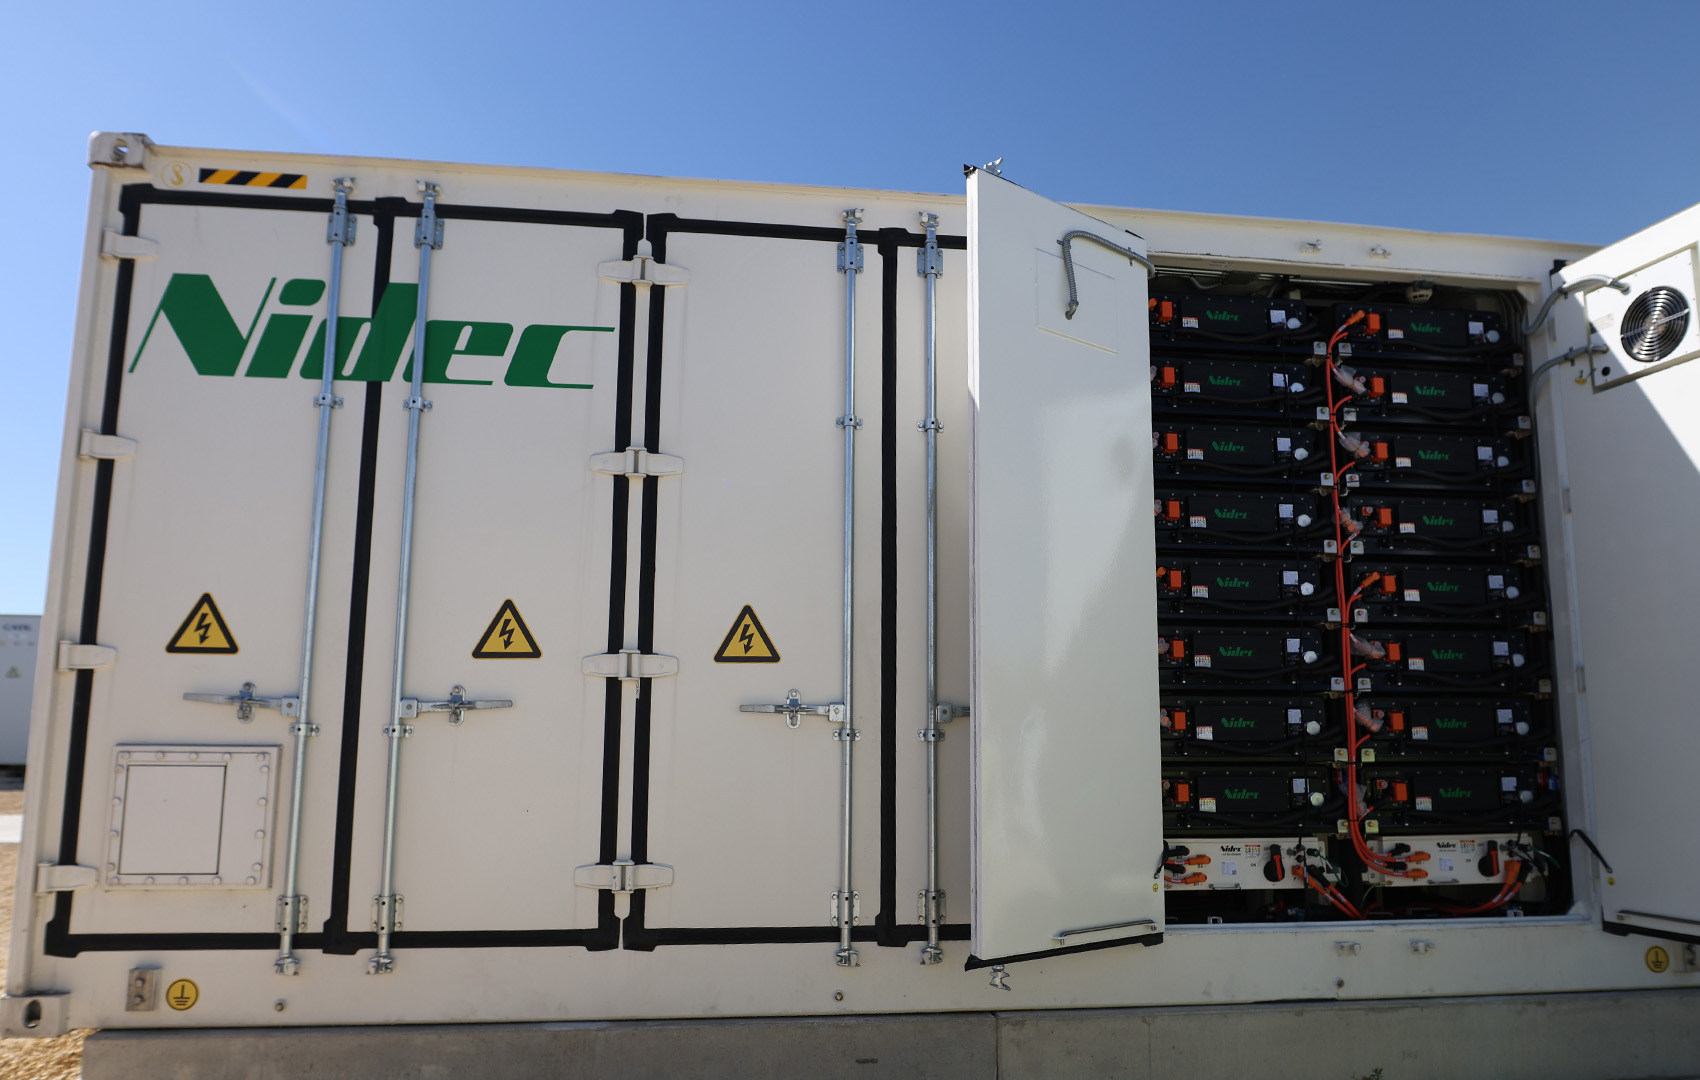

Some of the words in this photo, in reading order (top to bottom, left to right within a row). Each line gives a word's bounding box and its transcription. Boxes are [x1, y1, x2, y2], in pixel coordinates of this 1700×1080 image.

[1206, 310, 1239, 321] Nidec
[129, 273, 615, 389] Nidec
[1209, 376, 1242, 387] Nidec
[1212, 440, 1246, 452] Nidec
[1214, 508, 1248, 519] Nidec
[1216, 577, 1251, 588] Nidec
[1219, 646, 1254, 657] Nidec
[1221, 717, 1256, 728] Nidec
[1224, 788, 1259, 799] Nidec
